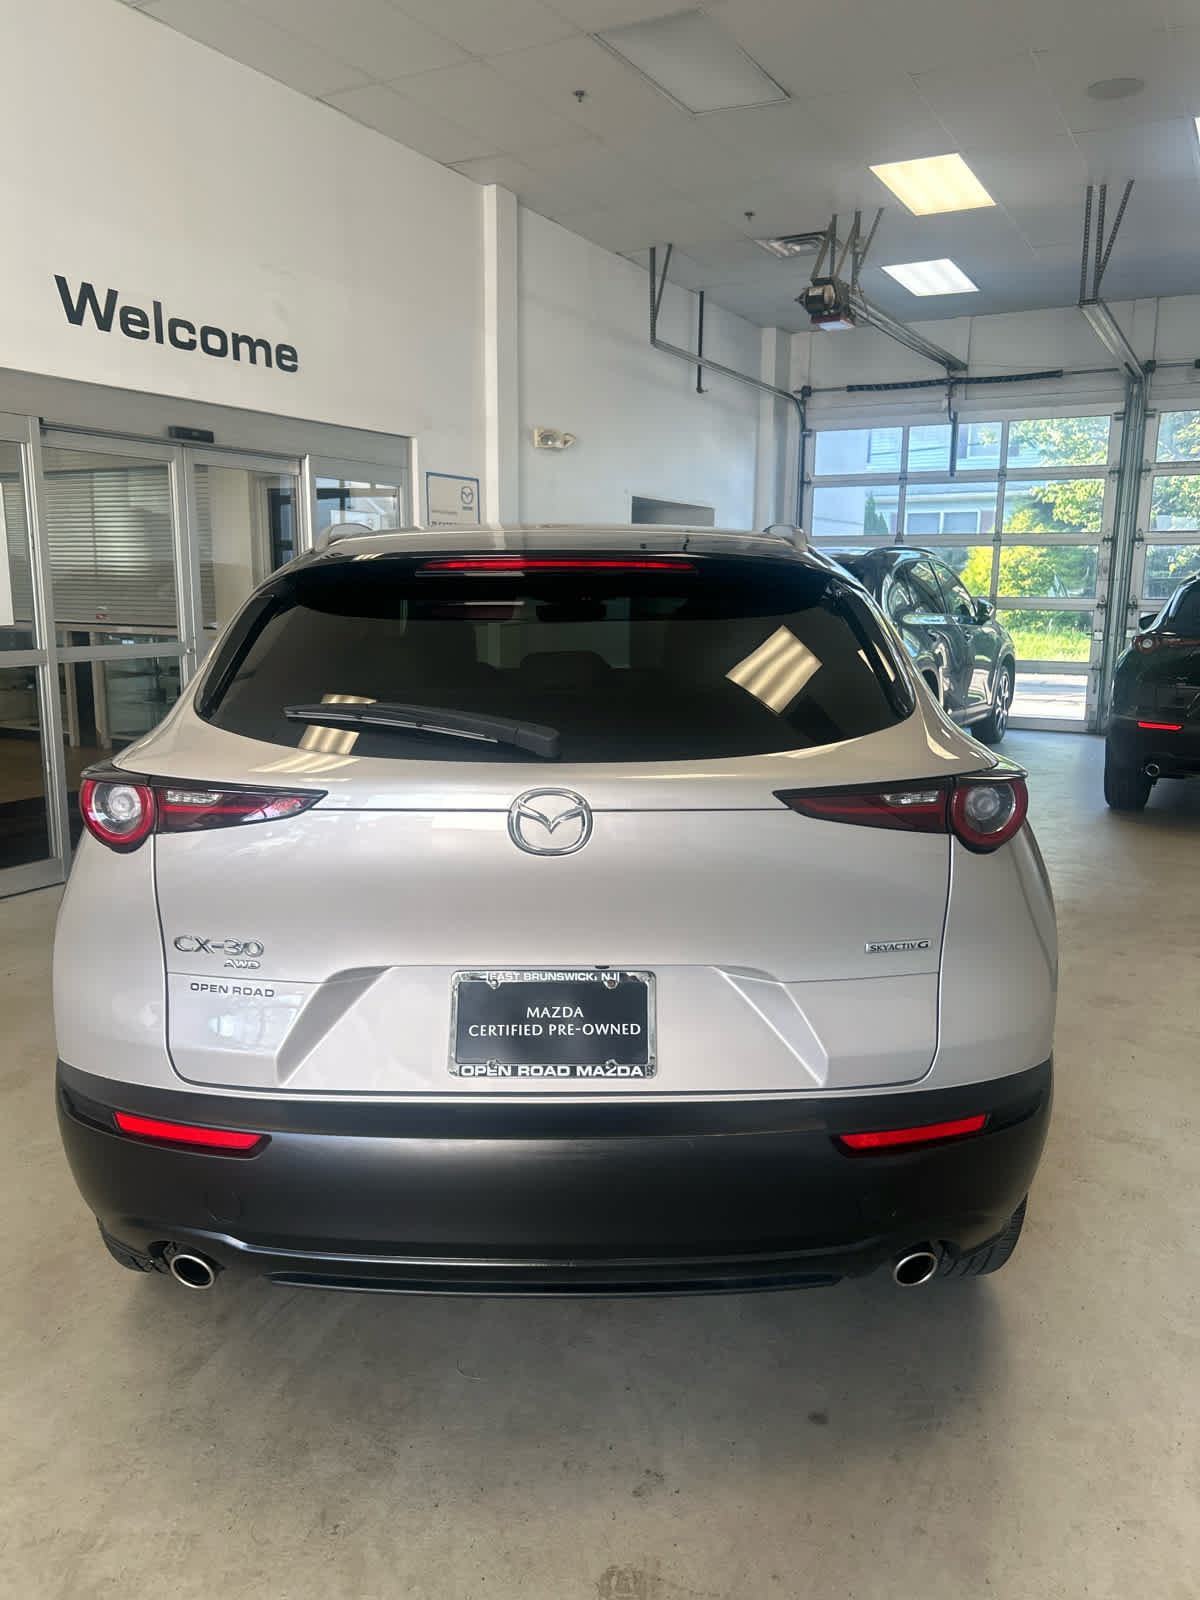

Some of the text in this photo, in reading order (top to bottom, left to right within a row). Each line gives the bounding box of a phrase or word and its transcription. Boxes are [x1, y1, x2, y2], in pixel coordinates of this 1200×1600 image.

[54, 274, 299, 373] Welcome
[174, 935, 265, 957] CX-30
[223, 959, 261, 970] AWD
[190, 982, 275, 998] OPEN ROAD
[526, 1006, 584, 1018] MAZDA
[468, 1023, 641, 1037] CERTIFIED PRE-OWNED
[461, 1065, 643, 1077] OPEN ROAD MAZDA
